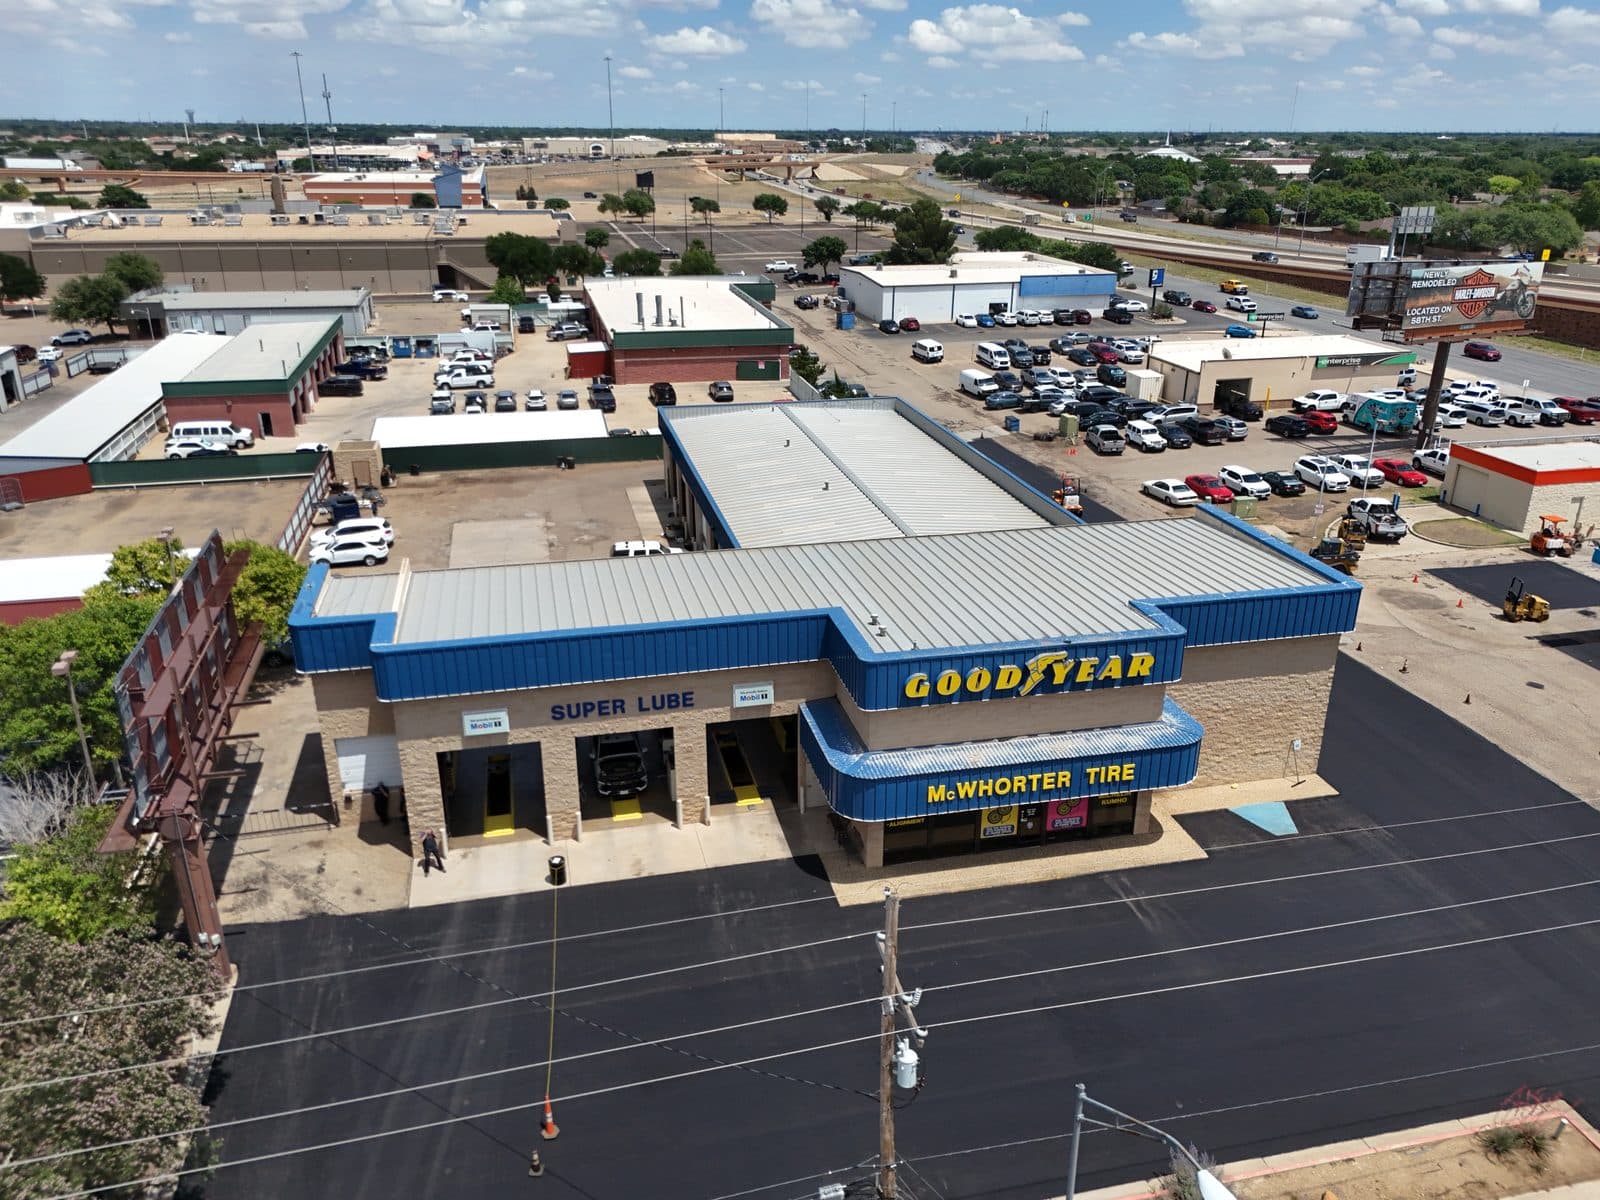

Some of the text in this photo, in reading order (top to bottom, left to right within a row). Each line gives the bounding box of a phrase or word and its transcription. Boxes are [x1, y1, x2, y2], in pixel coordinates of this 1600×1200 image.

[1423, 271, 1449, 279] NEWLY
[1411, 279, 1457, 289] REMODELED
[1455, 288, 1495, 300] HARLEY-DAVIDSON
[1406, 307, 1440, 316] LOCATED
[1319, 358, 1361, 366] enterprise
[904, 651, 1155, 698] GOODYEAR
[740, 693, 760, 702] Mobil
[551, 691, 695, 721] SUPER LUBE
[470, 721, 493, 730] Mobil
[927, 763, 1136, 803] McWHORTER TIRE
